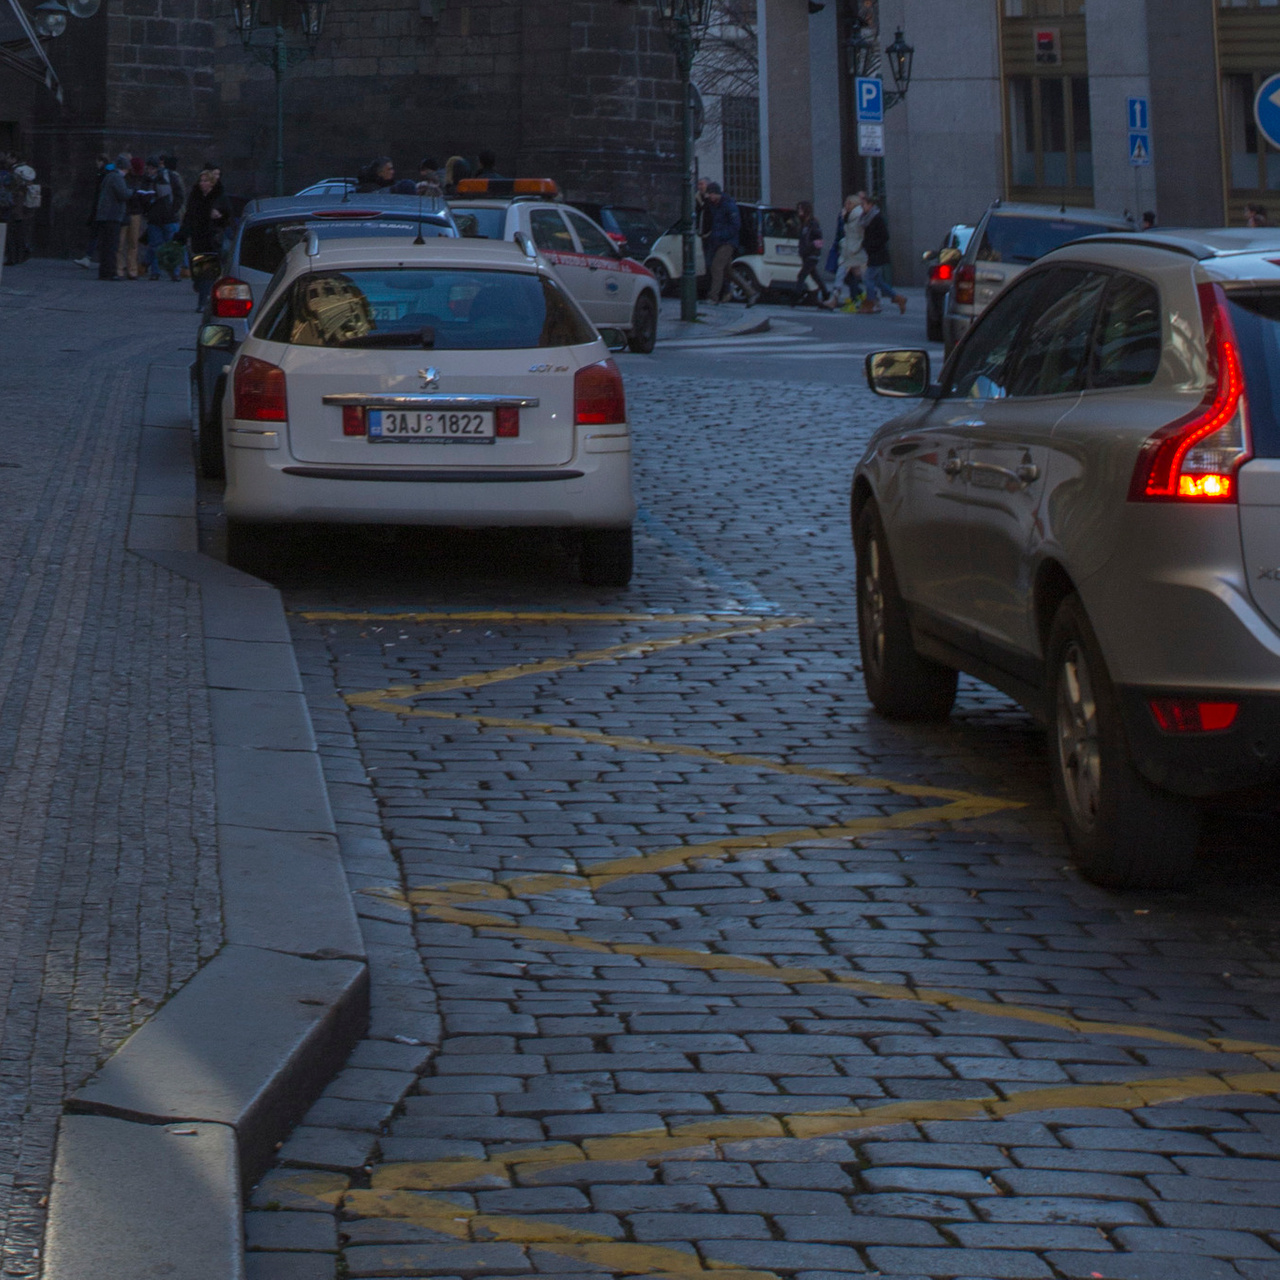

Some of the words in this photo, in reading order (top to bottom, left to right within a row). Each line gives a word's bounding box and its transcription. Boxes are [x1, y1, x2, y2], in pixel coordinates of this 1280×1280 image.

[861, 82, 877, 109] P
[385, 413, 422, 434] 3AJ
[437, 413, 485, 434] 1822
